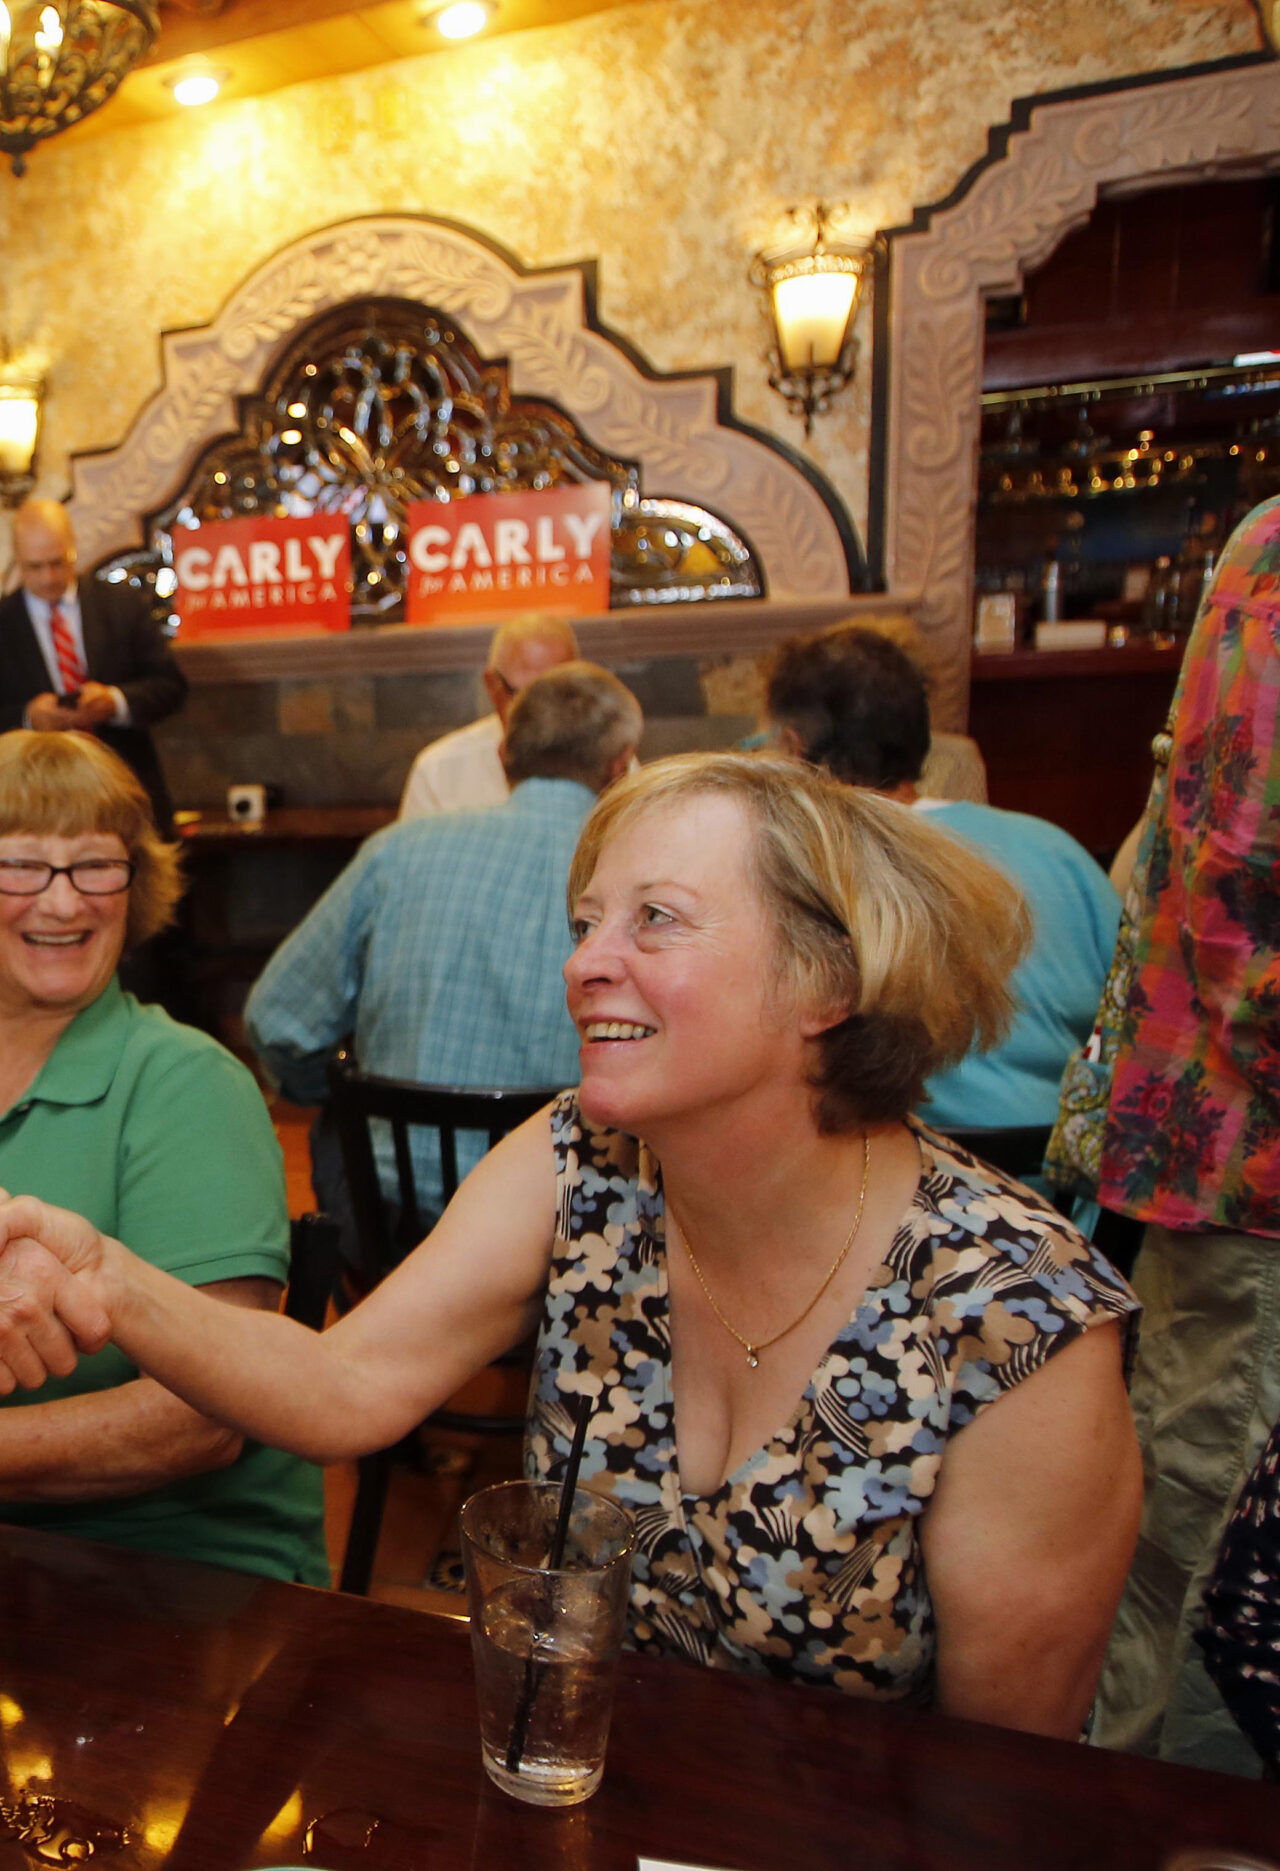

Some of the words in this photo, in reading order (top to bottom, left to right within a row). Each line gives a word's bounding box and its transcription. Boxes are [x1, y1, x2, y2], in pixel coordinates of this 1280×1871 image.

[177, 534, 345, 591] CARLY
[410, 513, 604, 573] CARLY
[209, 582, 338, 610] AMERICA
[448, 562, 594, 593] AMERICA
